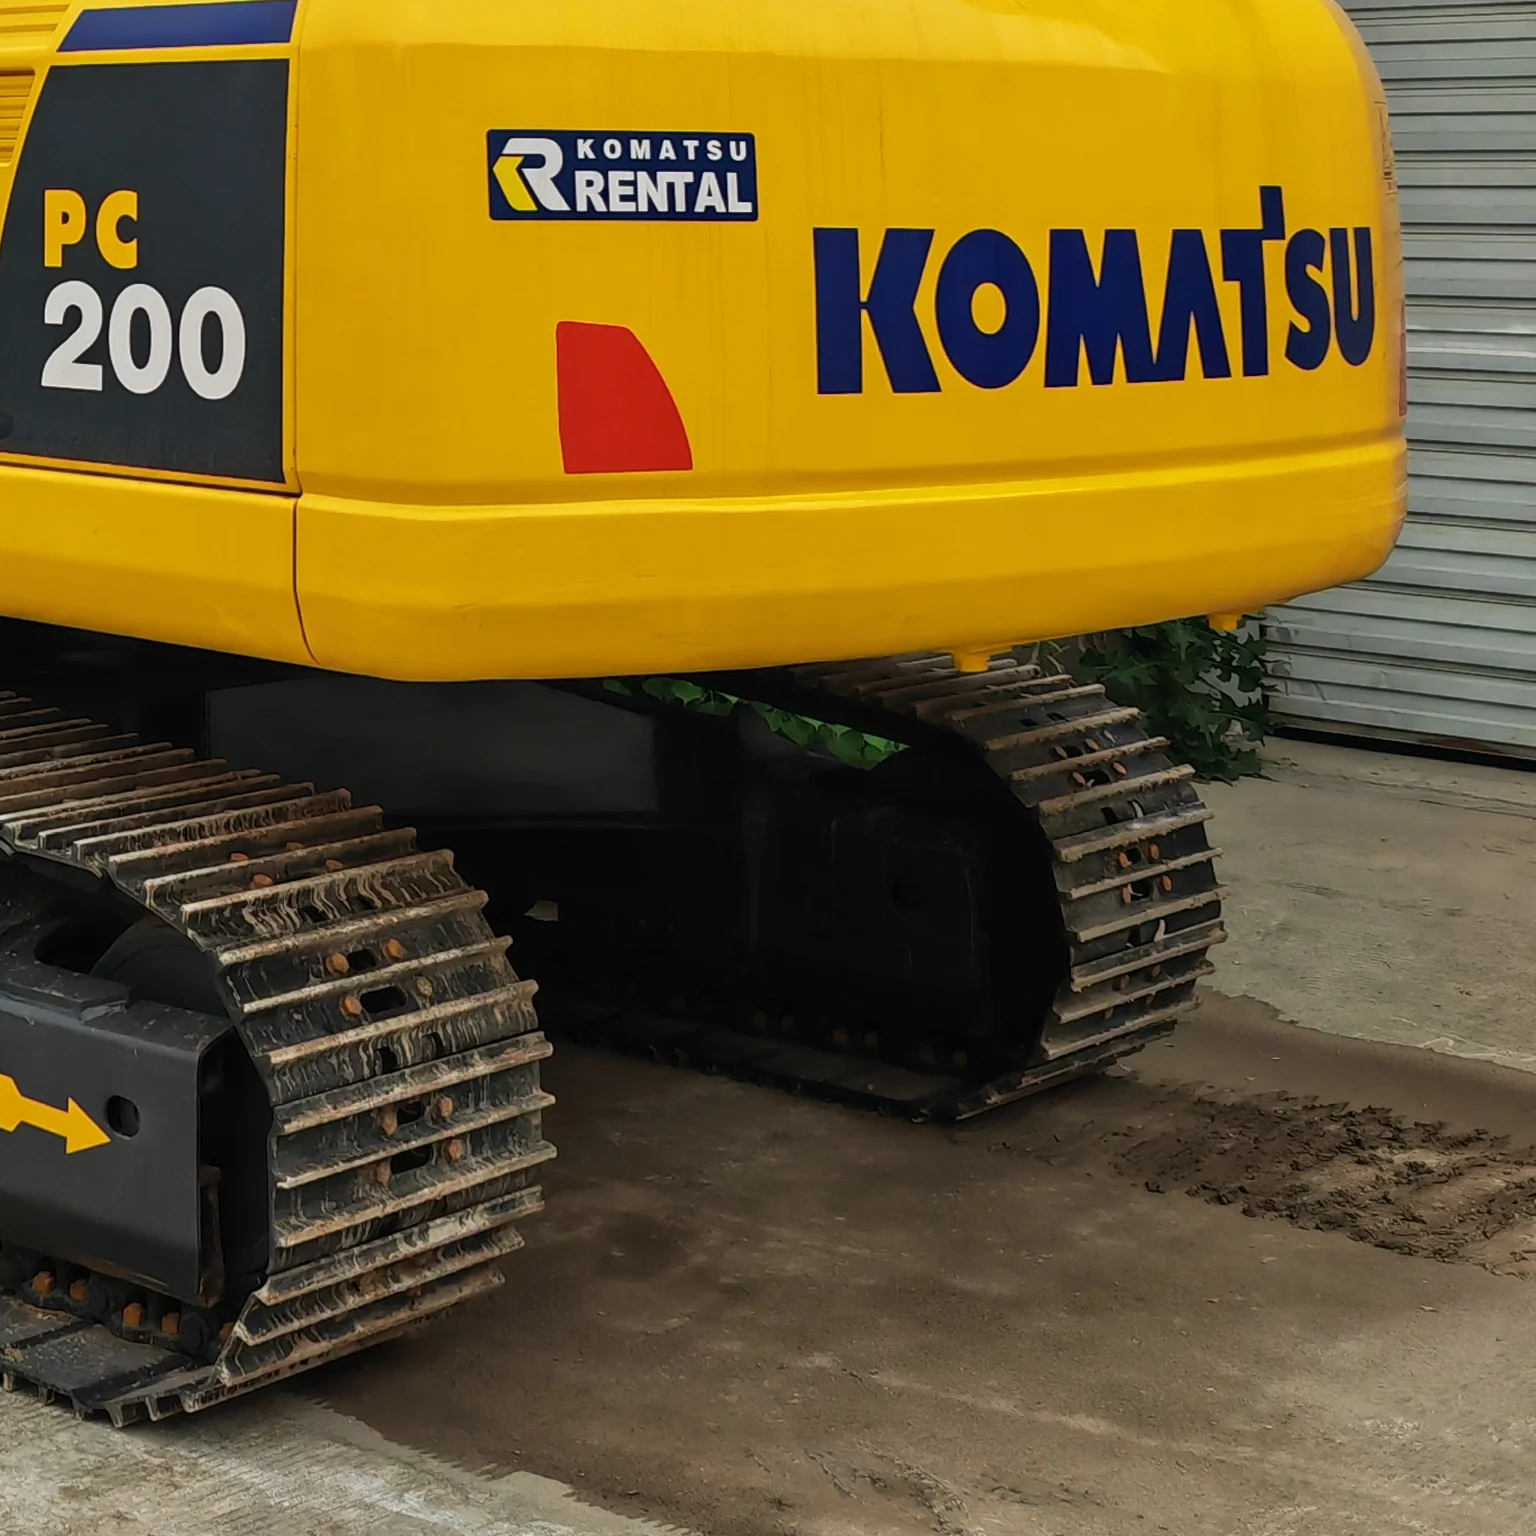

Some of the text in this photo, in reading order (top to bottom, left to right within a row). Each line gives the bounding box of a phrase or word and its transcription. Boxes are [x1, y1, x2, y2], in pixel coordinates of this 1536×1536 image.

[577, 139, 747, 161] KOMATSU
[44, 189, 138, 269] PC
[574, 170, 753, 213] RENTAL
[812, 185, 1376, 395] KOMATSU
[41, 280, 246, 400] 200
